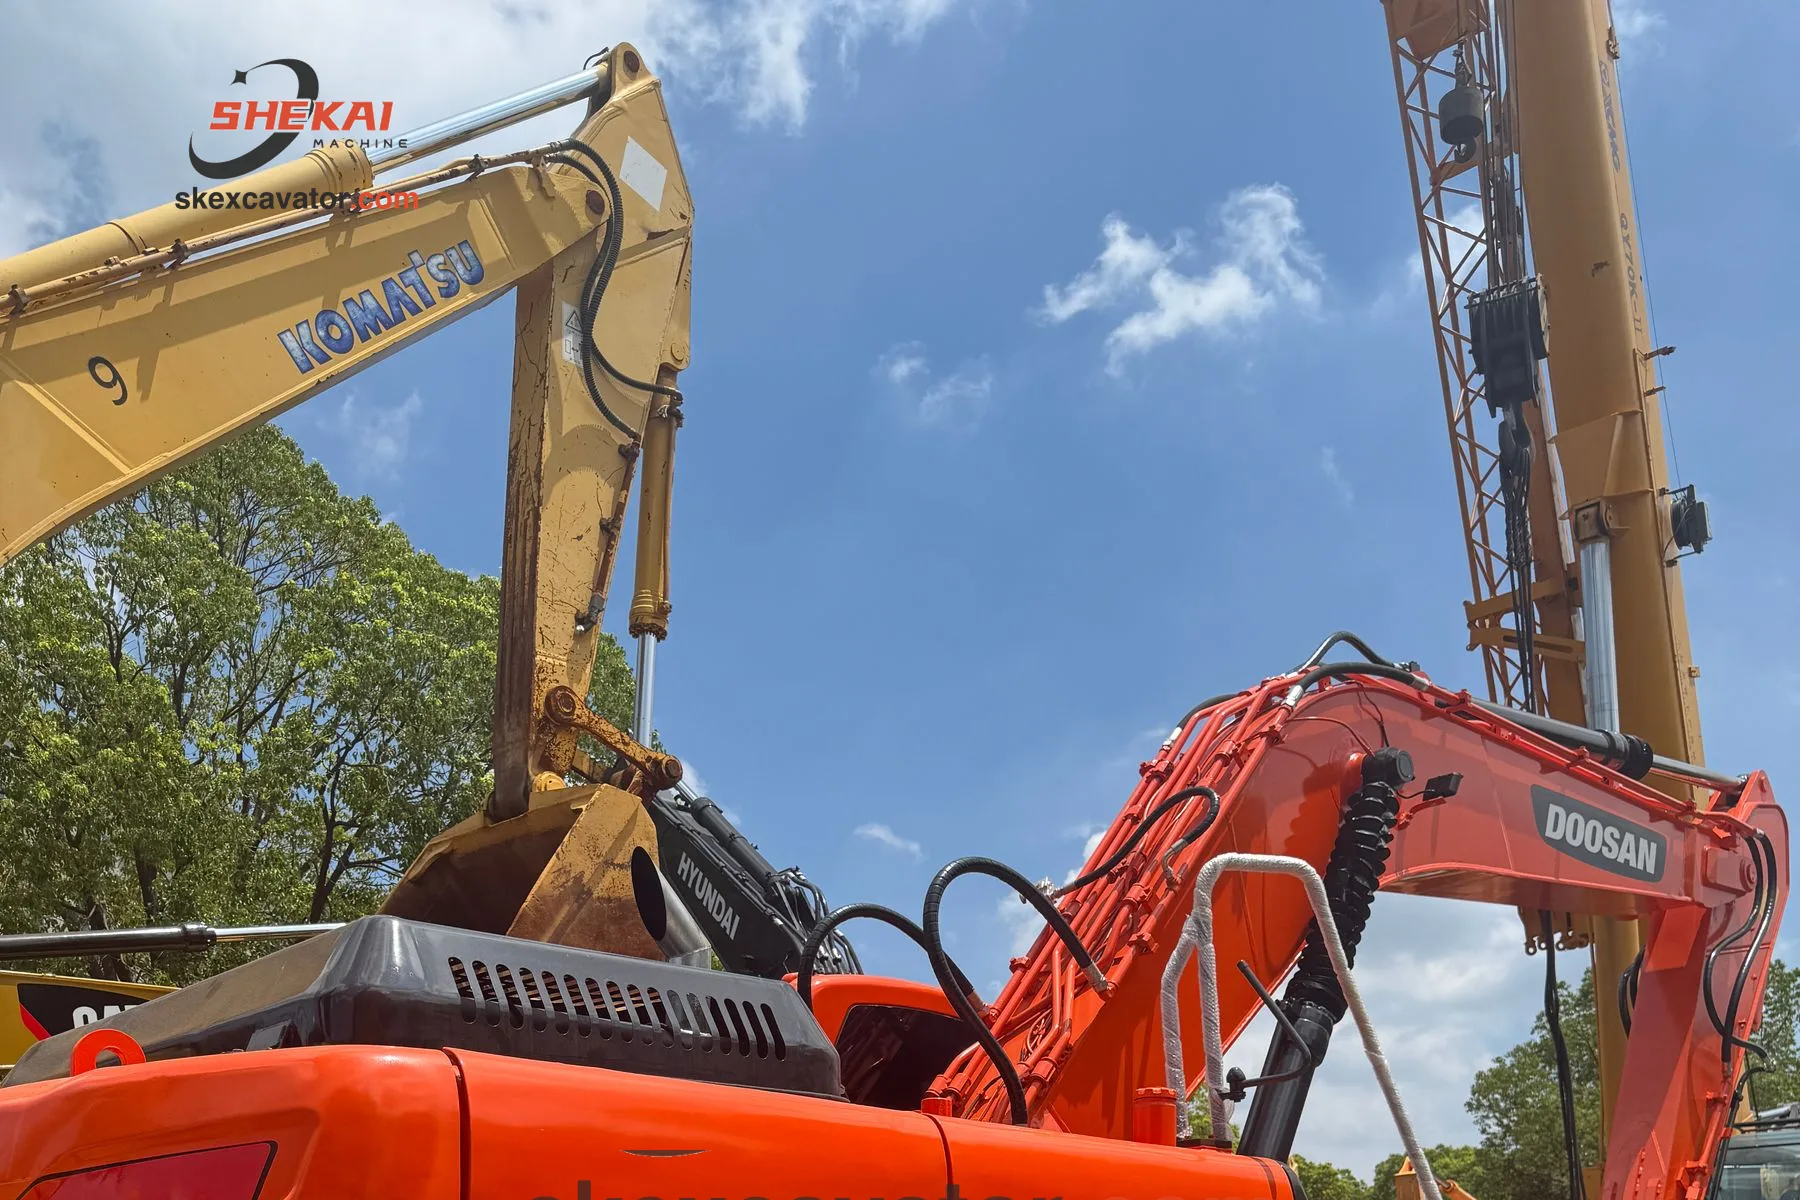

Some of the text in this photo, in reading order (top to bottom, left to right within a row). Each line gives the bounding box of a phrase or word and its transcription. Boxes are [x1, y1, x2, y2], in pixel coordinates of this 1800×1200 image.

[276, 239, 485, 375] KOMATSU
[87, 355, 128, 406] 9
[1544, 803, 1657, 875] DOOSAN
[677, 851, 741, 941] HYUNDAI
